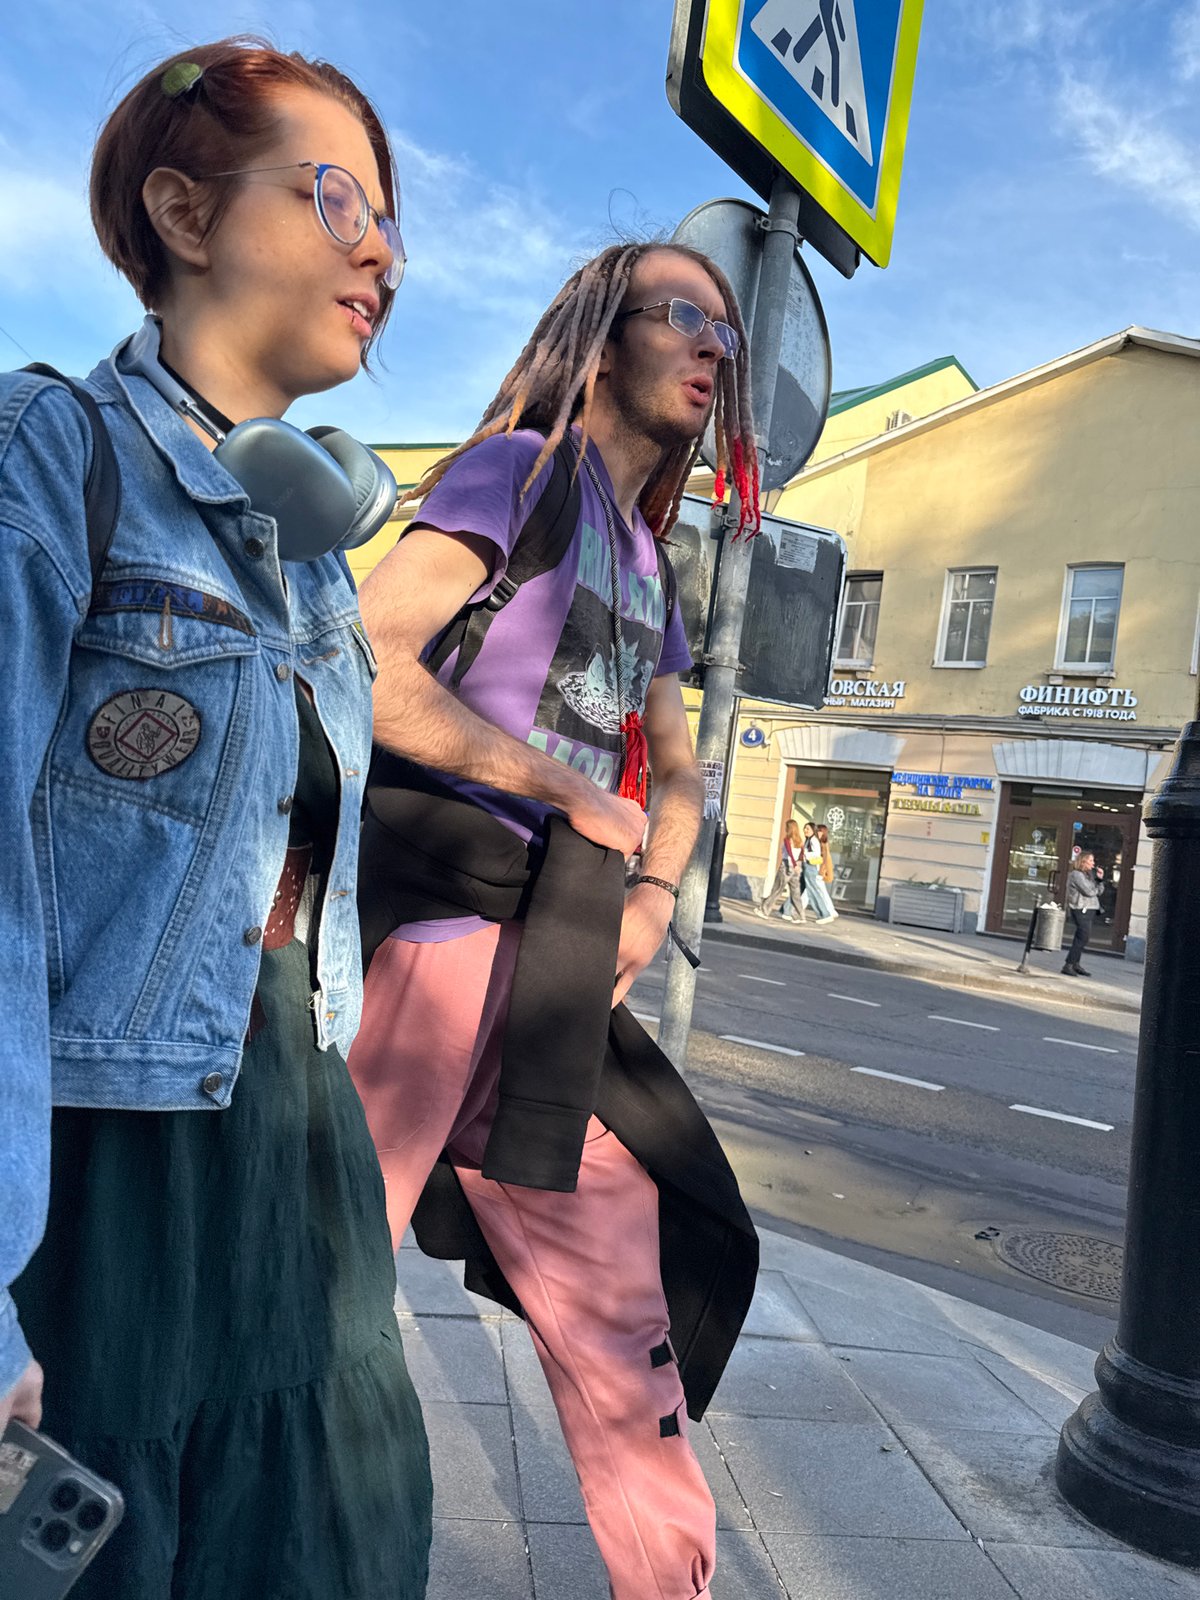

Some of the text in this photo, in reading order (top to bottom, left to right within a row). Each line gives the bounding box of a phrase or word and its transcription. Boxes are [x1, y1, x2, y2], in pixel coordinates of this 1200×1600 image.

[850, 698, 895, 708] МАГАЗИН
[1019, 685, 1138, 708] ФИНИФТЬ
[101, 693, 186, 725] FINAL
[1017, 705, 1137, 721] ФАБРИКА С 1918 ГОДА
[748, 729, 757, 741] 4
[91, 728, 198, 777] QUALITY WEAR
